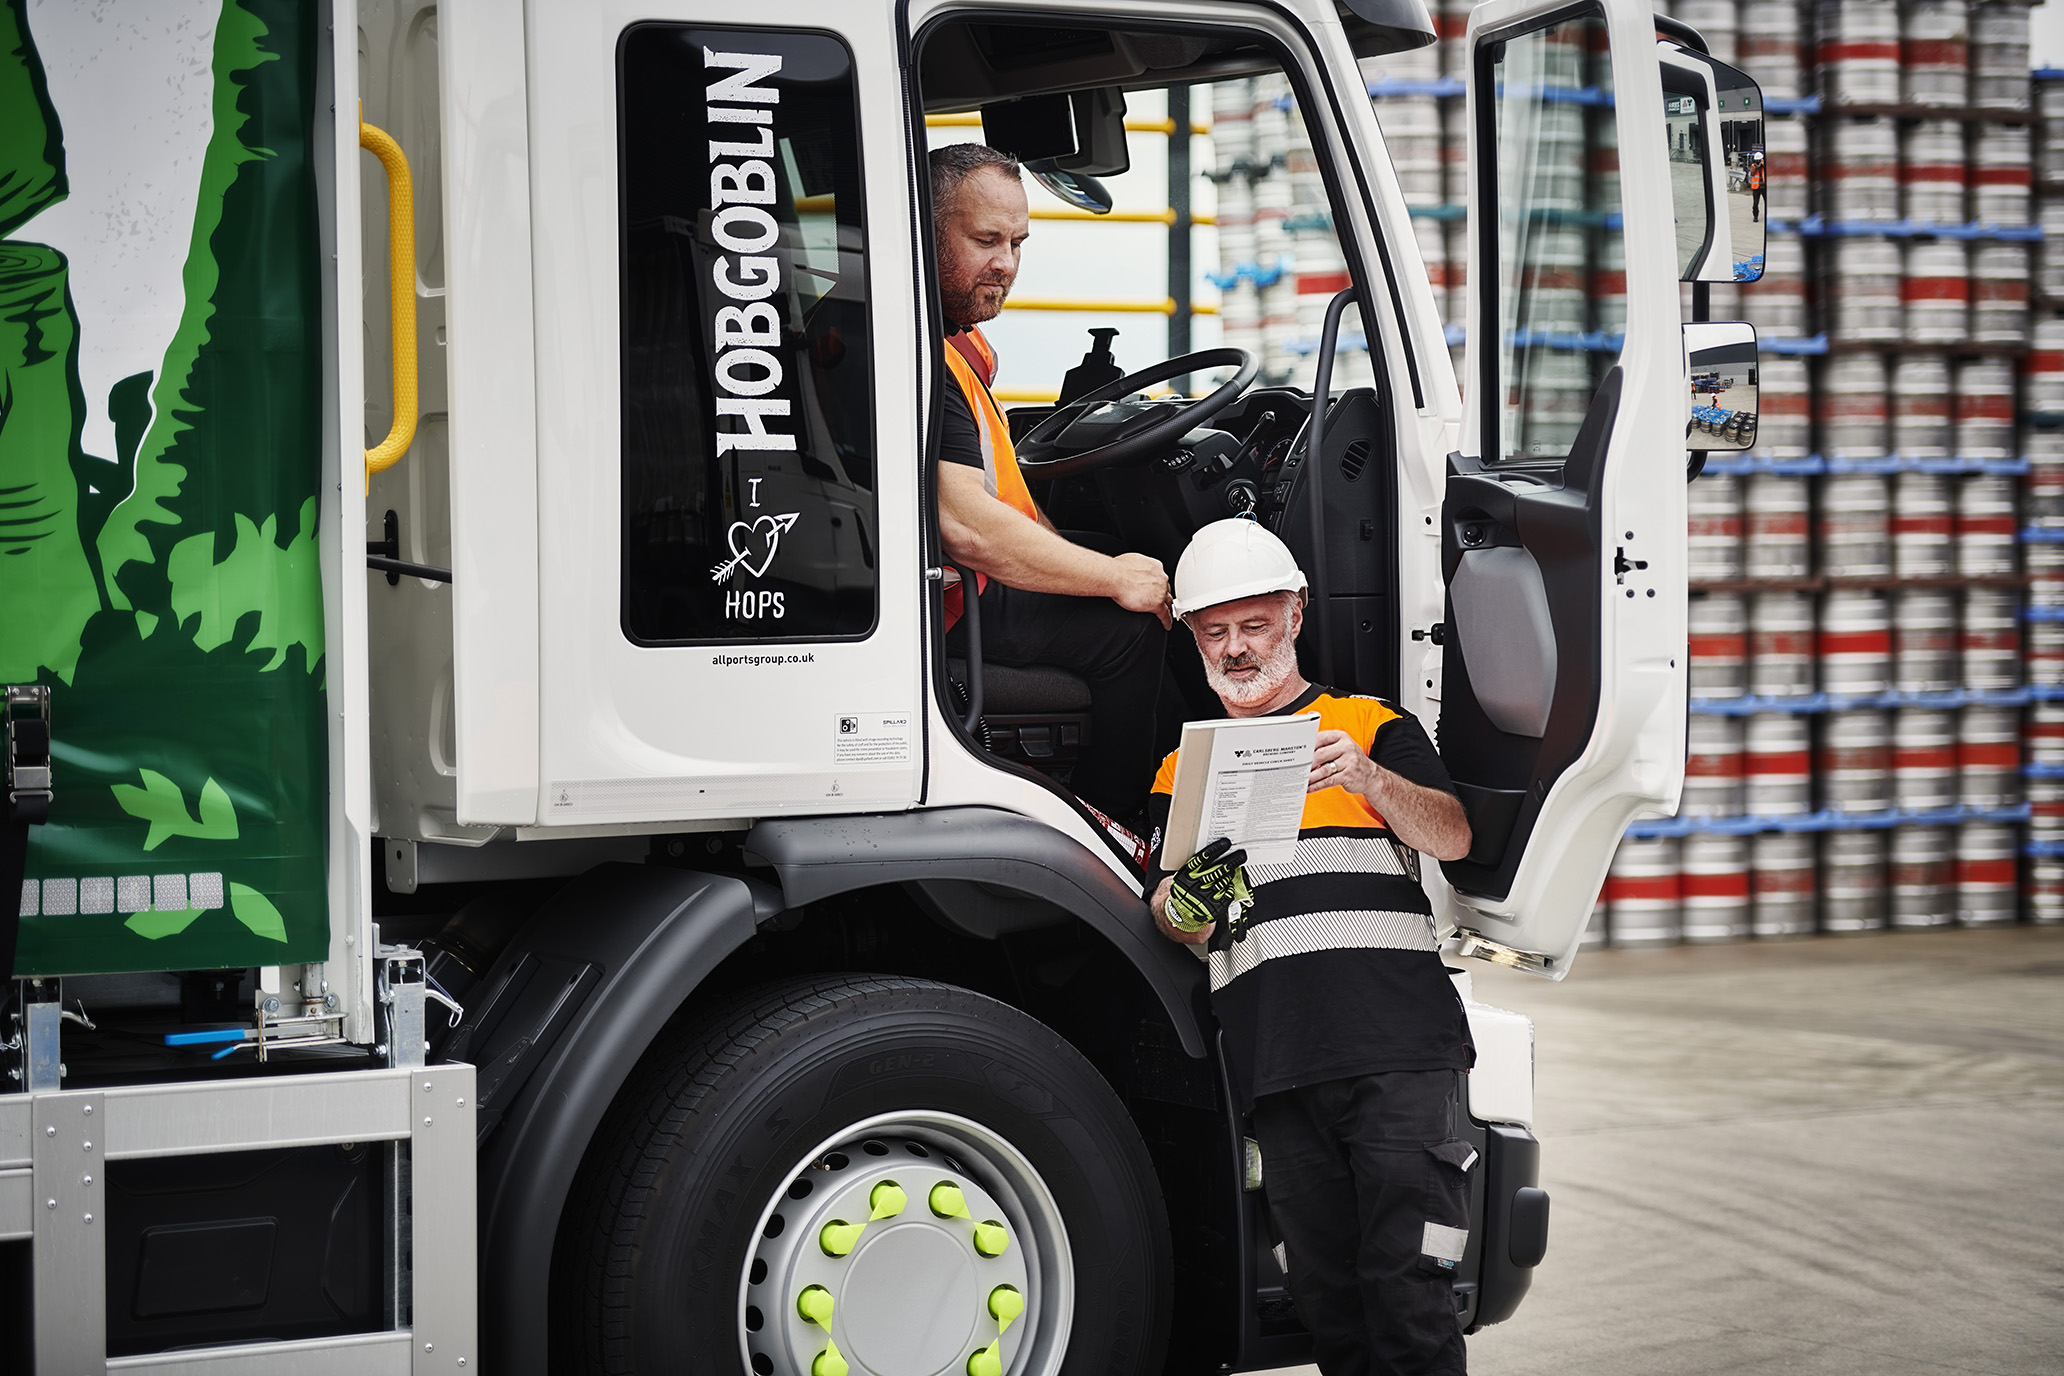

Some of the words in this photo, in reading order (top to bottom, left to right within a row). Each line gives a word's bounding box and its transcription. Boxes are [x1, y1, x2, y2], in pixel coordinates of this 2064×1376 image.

[703, 45, 797, 458] HOBGOBLIN
[725, 590, 785, 619] HOPS
[712, 653, 815, 667] allportsgroup.co.uk
